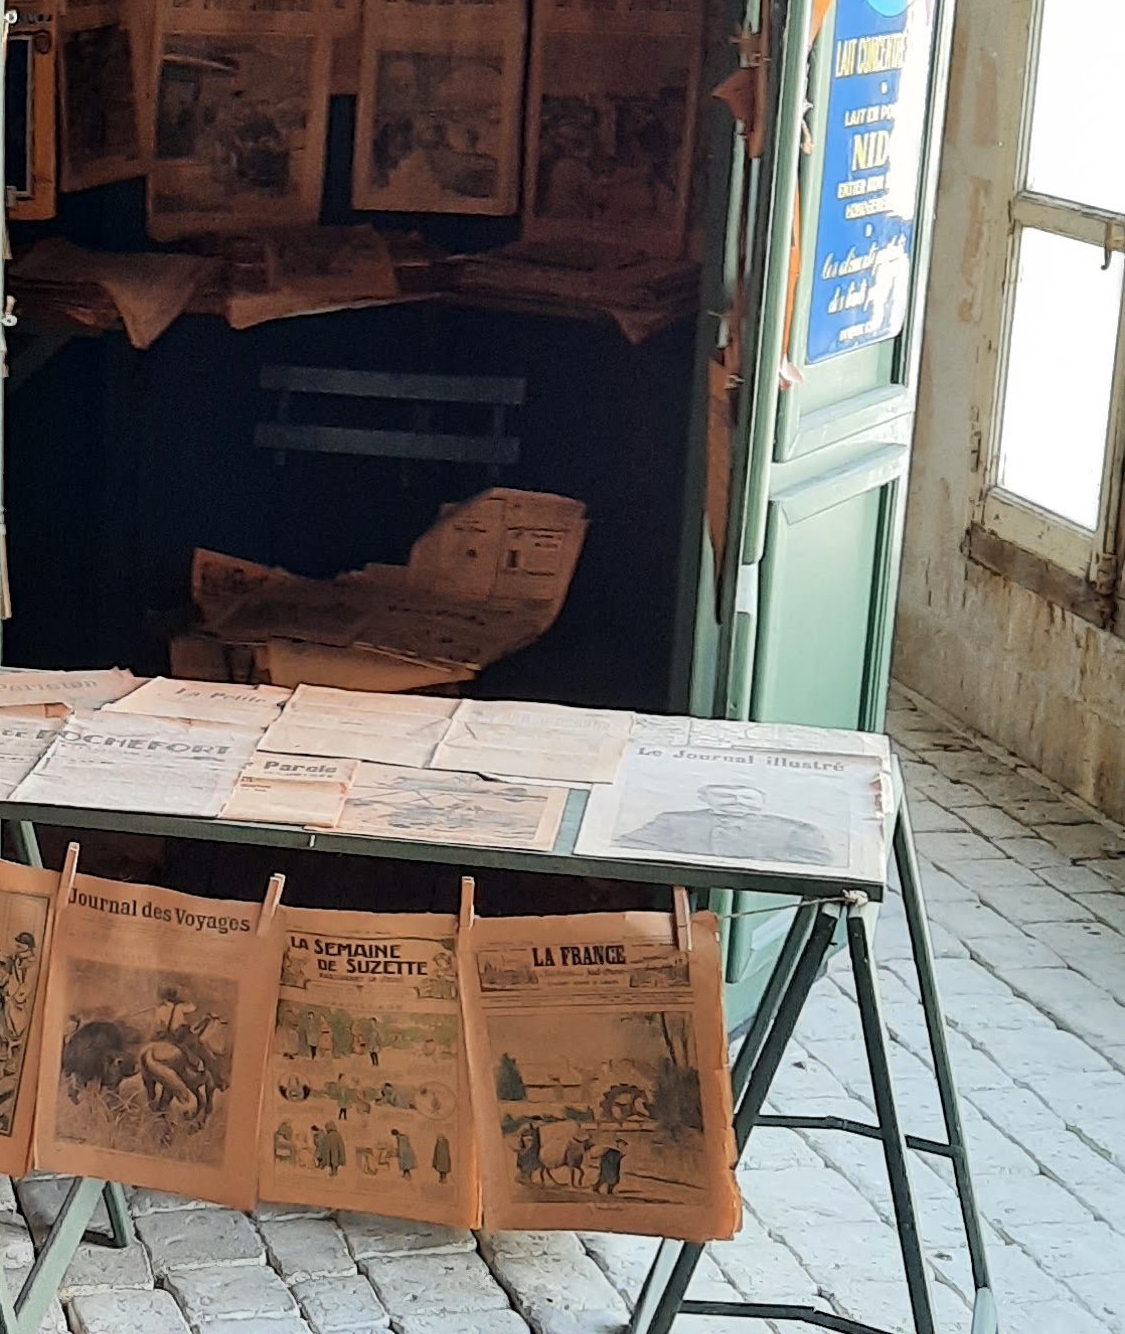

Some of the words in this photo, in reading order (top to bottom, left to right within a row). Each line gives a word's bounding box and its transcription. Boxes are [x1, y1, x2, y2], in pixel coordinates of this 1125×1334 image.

[835, 39, 858, 78] LAIT
[35, 729, 232, 756] ROCHEFORT
[637, 747, 662, 757] Le
[673, 750, 754, 766] Journal
[765, 756, 845, 773] illustré
[68, 887, 137, 917] Journal
[142, 901, 172, 923] des
[174, 908, 251, 935] Voyages
[291, 935, 309, 951] LA
[313, 938, 402, 959] SEMAINE
[531, 947, 556, 967] LA
[560, 945, 627, 966] FRANCE
[317, 958, 336, 972] DE
[346, 958, 428, 976] SUZETTE
